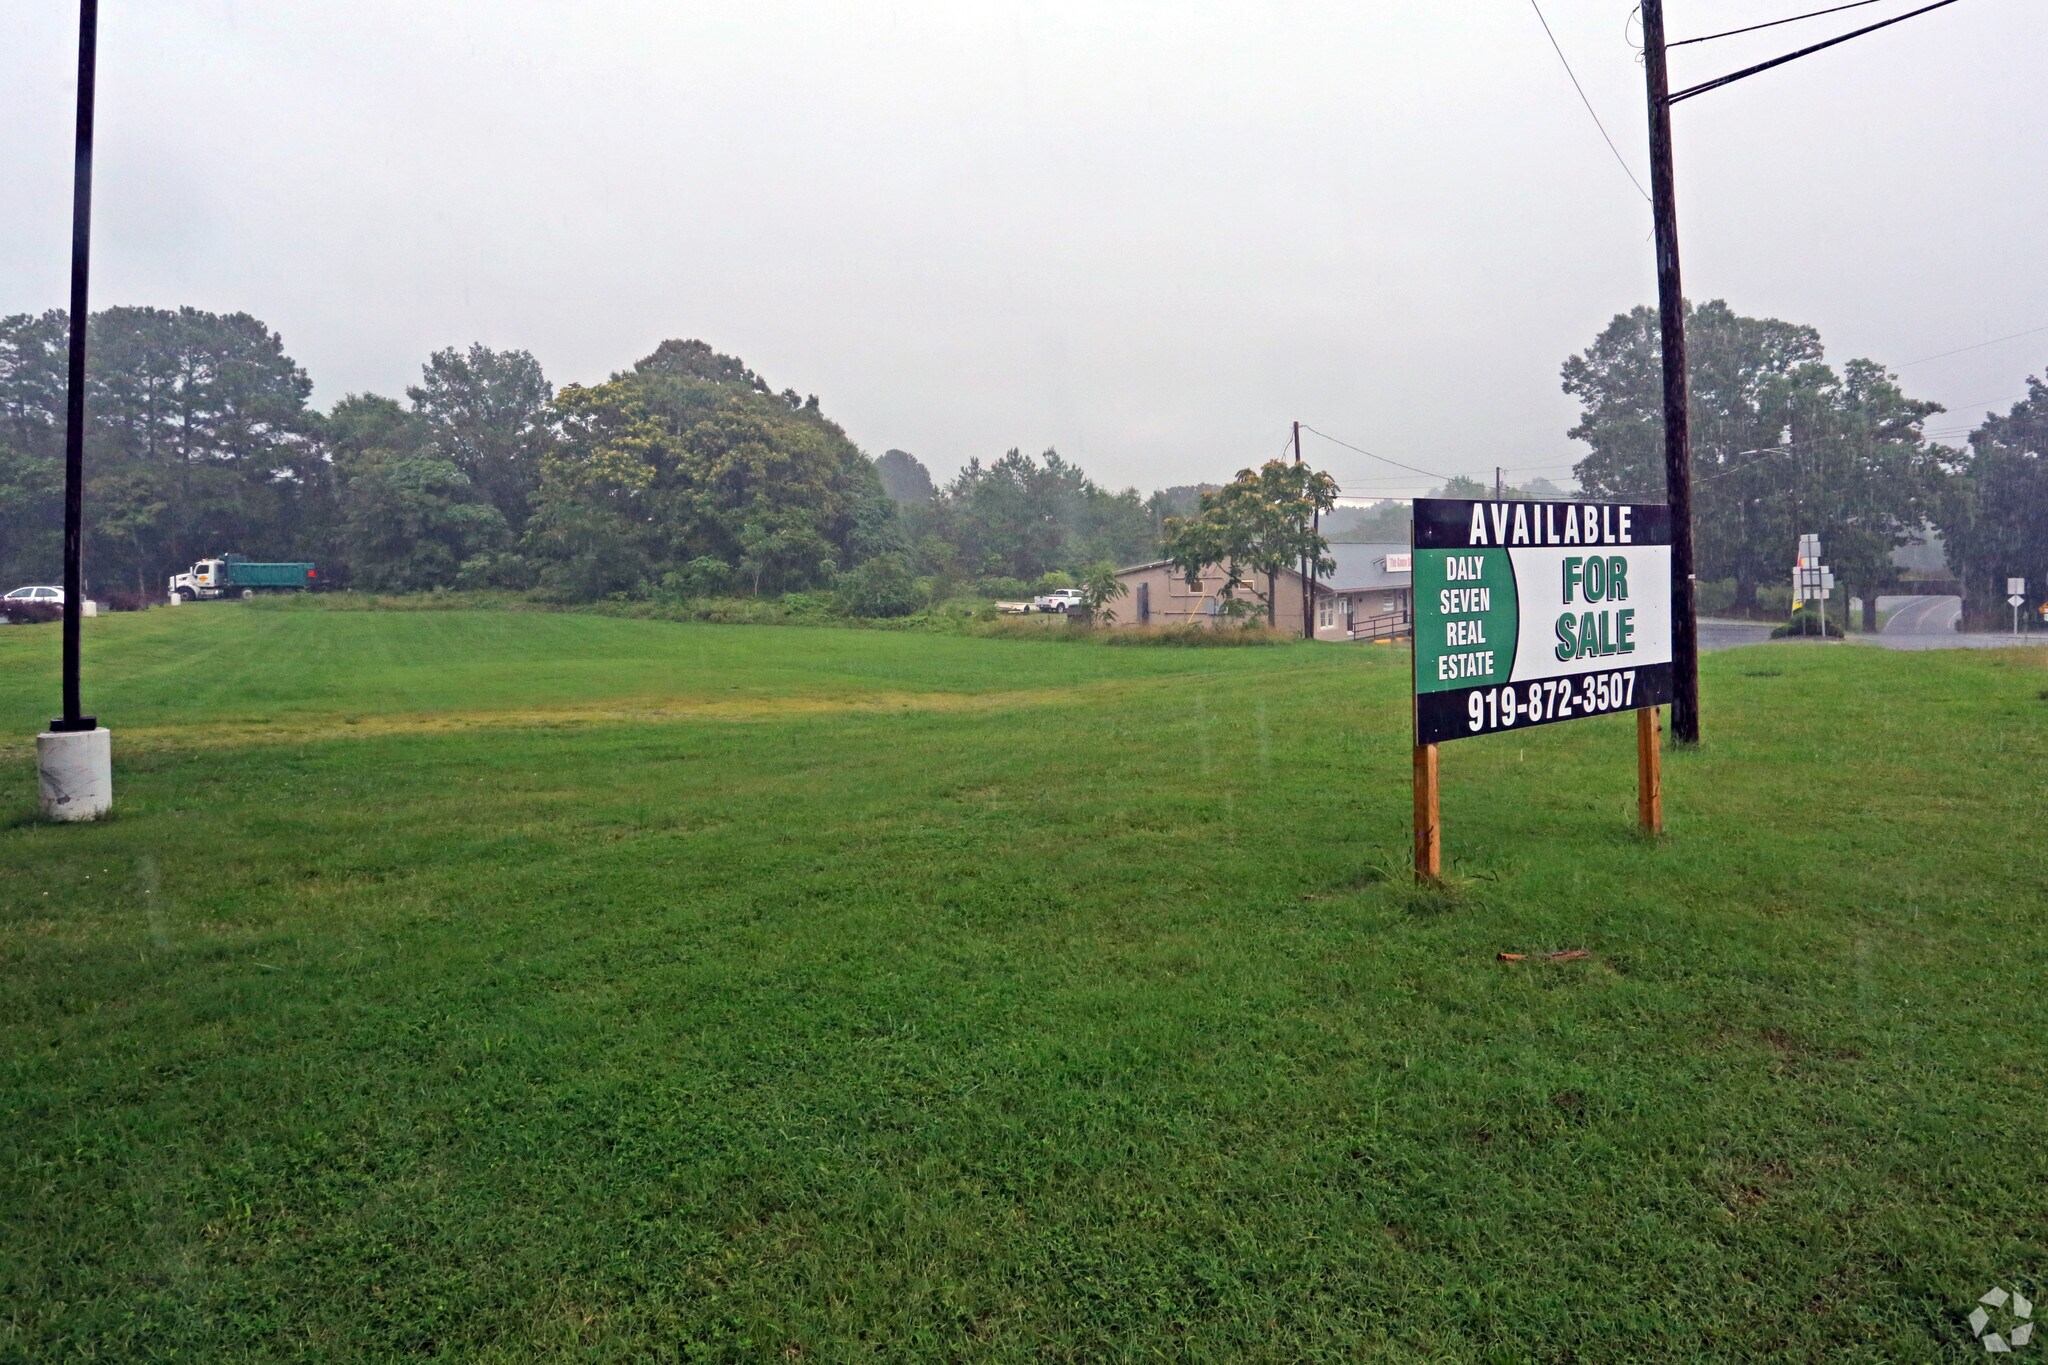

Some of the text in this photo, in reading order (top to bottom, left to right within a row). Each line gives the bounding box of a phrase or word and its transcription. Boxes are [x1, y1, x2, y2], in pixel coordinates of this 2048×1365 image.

[1470, 503, 1632, 545] AVAILABLE
[1446, 556, 1484, 581] DALY
[1562, 555, 1629, 605] FOR
[1440, 588, 1490, 614] SEVEN
[1446, 620, 1486, 646] REAL
[1555, 608, 1636, 662] SALE
[1438, 651, 1494, 680] ESTATE
[1469, 670, 1636, 731] 919-872-3507
